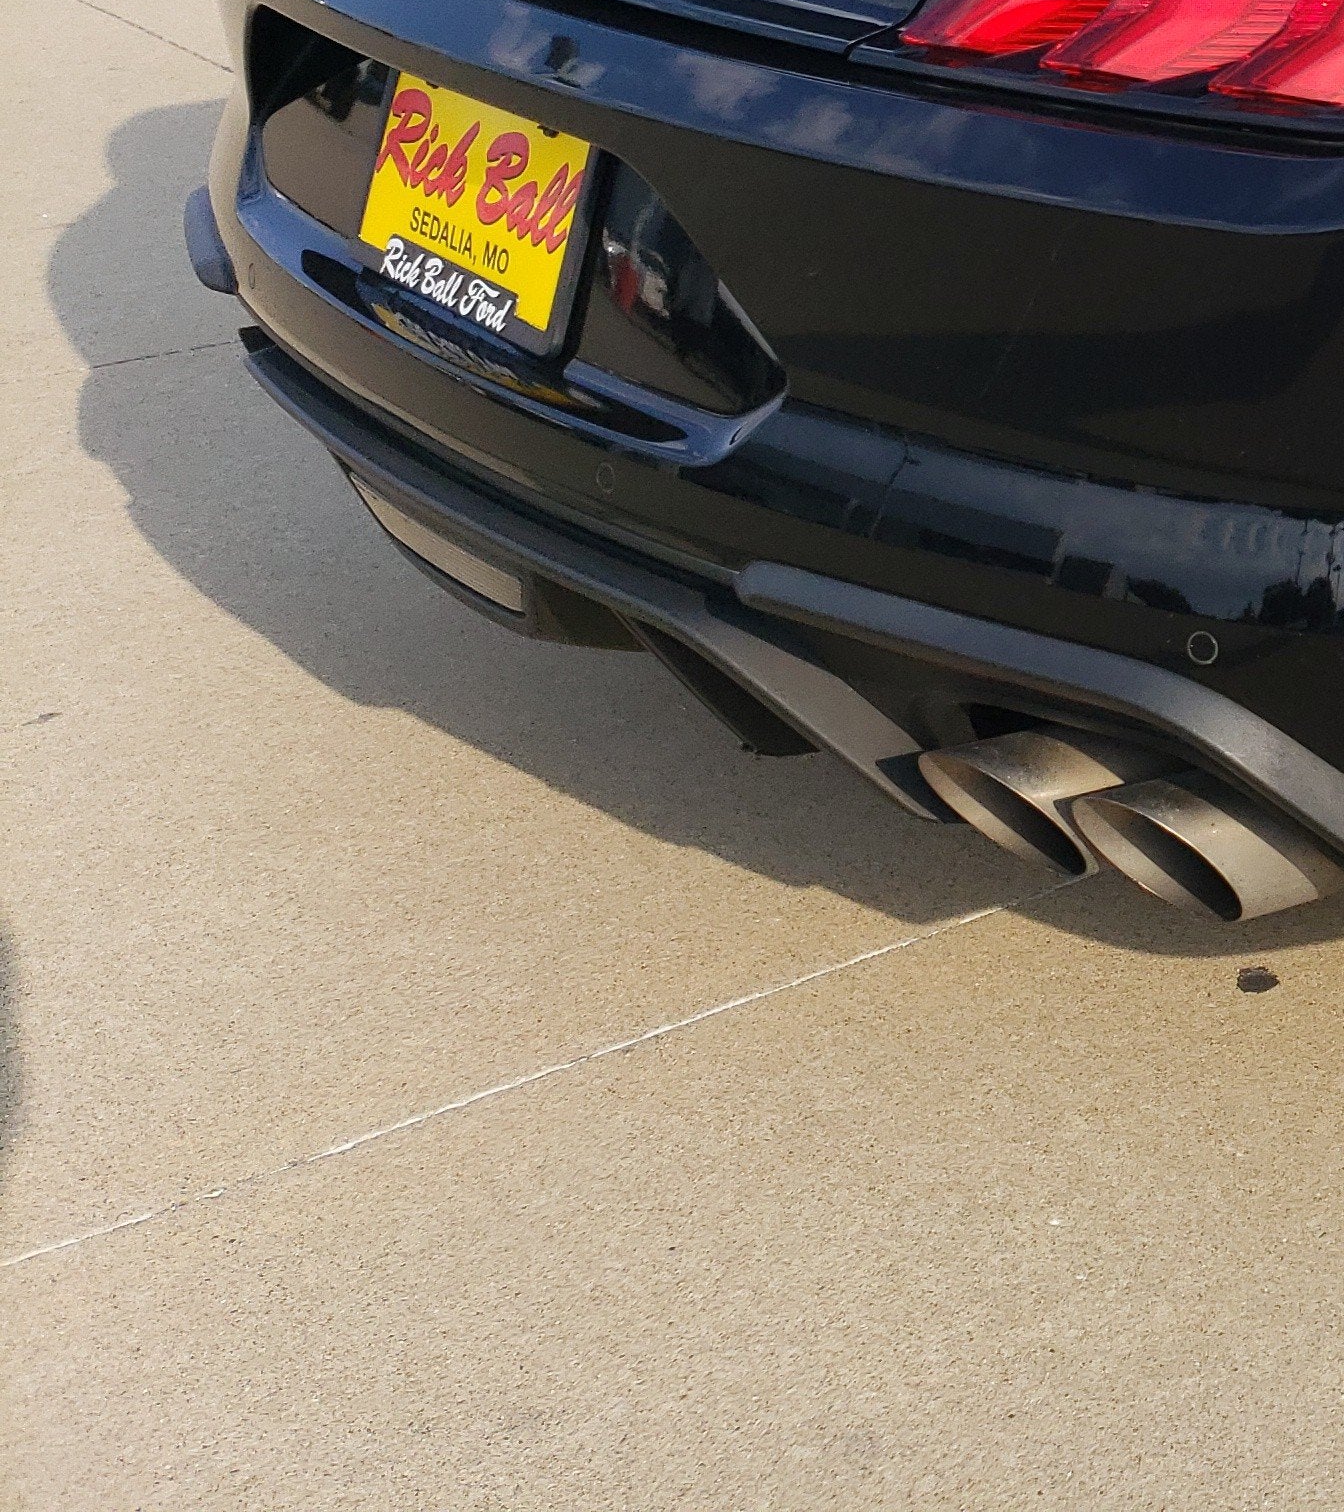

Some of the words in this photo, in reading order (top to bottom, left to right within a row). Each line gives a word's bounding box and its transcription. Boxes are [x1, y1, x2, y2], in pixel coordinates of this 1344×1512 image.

[375, 88, 481, 208] Rick
[476, 131, 585, 254] Ball
[379, 237, 422, 289] Rick
[420, 257, 463, 308] Ball
[459, 279, 514, 332] Ford
[409, 206, 477, 266] SEDALIA,
[482, 241, 510, 275] MO
